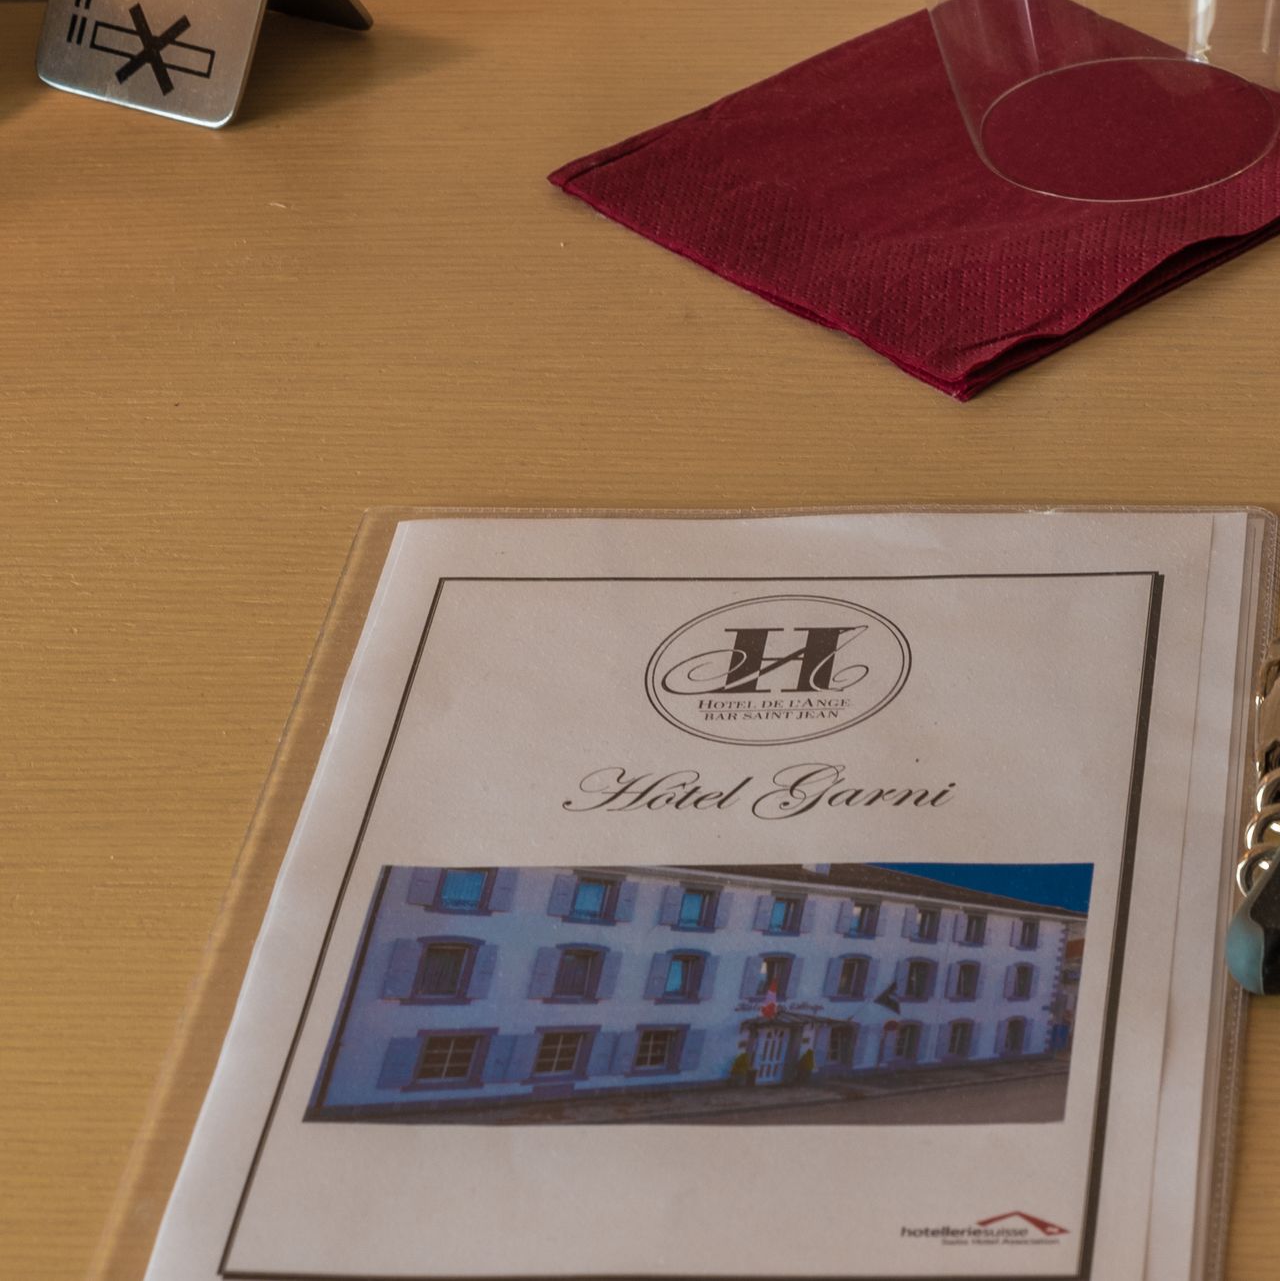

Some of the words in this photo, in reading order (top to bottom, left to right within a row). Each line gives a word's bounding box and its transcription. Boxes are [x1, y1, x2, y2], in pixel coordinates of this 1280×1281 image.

[698, 699, 756, 709] HOTEL
[762, 700, 783, 708] DE
[789, 698, 850, 708] L'ANGE
[704, 713, 737, 721] BAR
[744, 711, 794, 720] SAINT
[796, 710, 839, 720] JEAN
[562, 766, 754, 812] Hôtel
[751, 762, 957, 819] Garni
